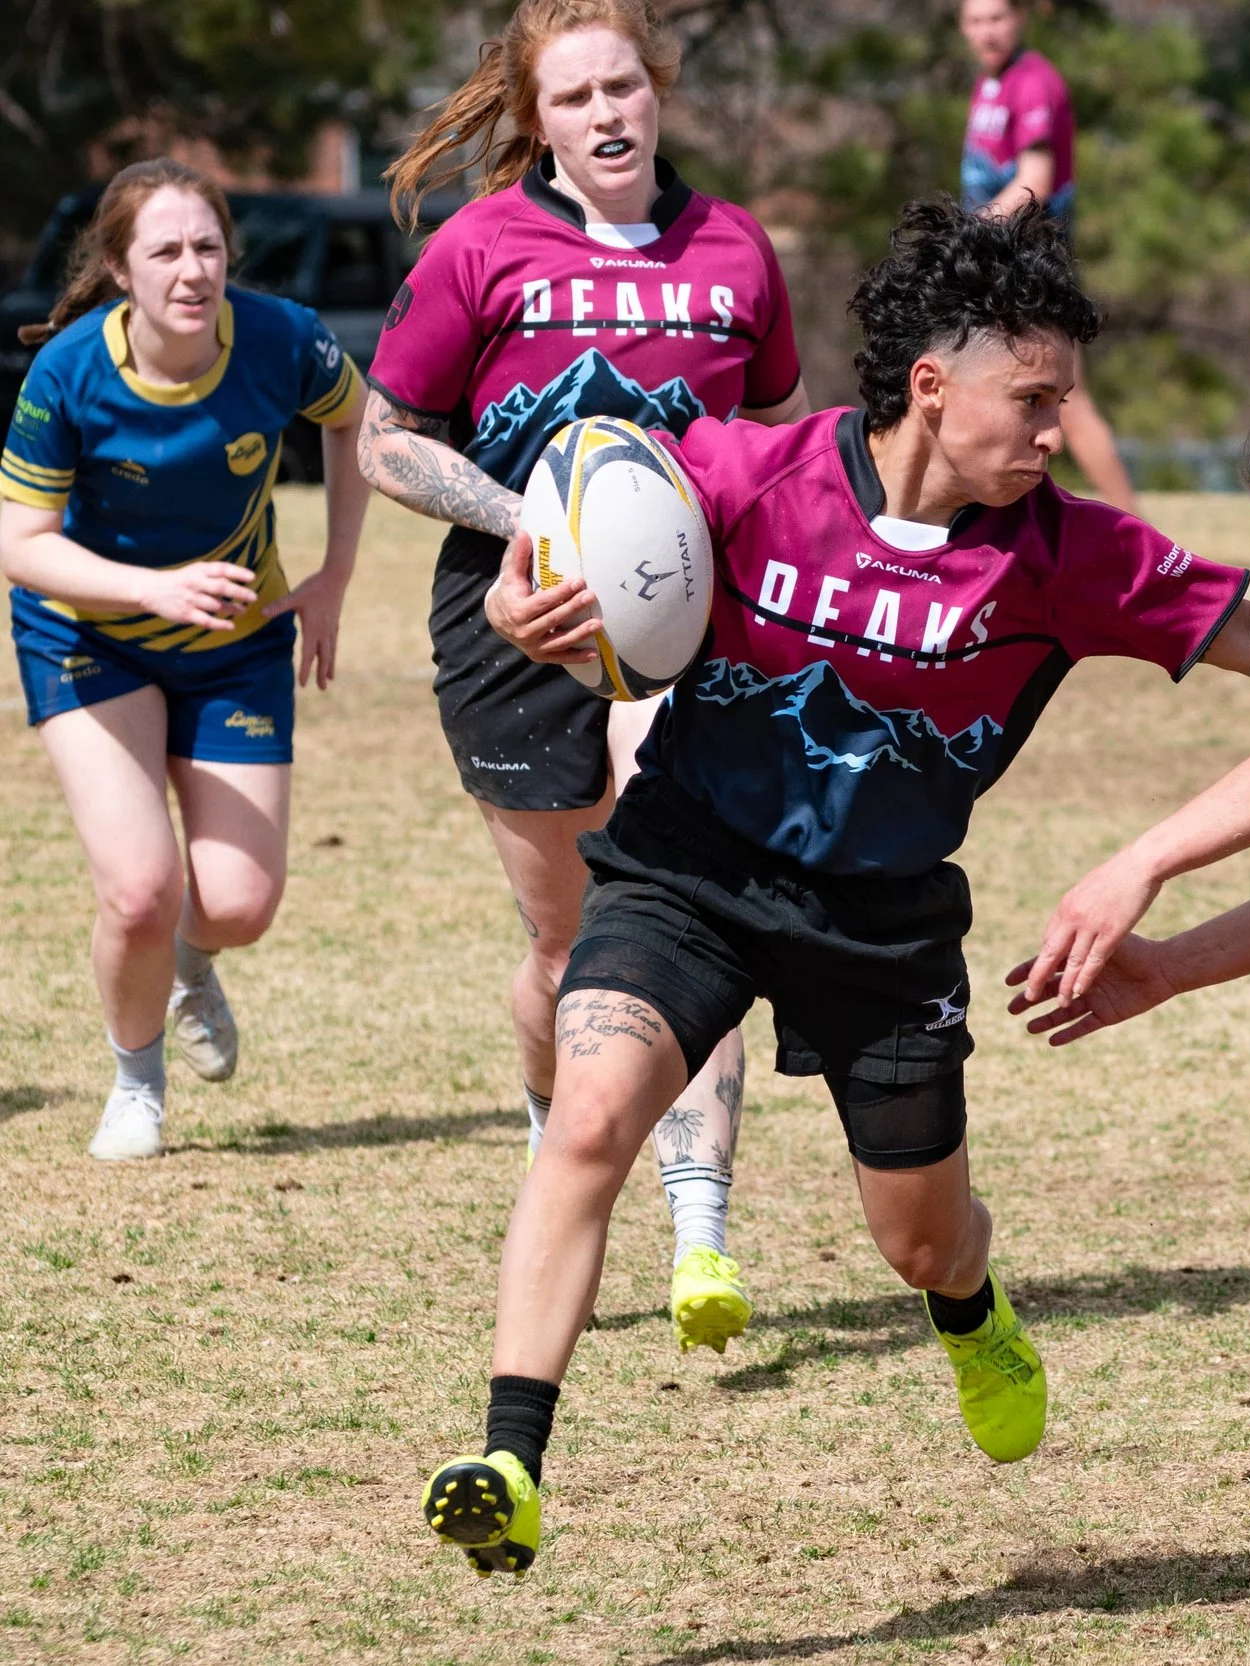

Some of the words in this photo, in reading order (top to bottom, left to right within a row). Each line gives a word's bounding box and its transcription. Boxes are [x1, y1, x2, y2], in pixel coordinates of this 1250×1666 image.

[604, 258, 667, 269] AKUMA
[522, 278, 735, 343] PEAKS
[538, 535, 551, 590] OUNTAIN
[676, 532, 695, 603] TYTAN
[870, 560, 942, 584] AKUMA
[754, 558, 998, 669] PEAKS
[809, 625, 947, 661] PIKES
[480, 760, 531, 771] AKUMA
